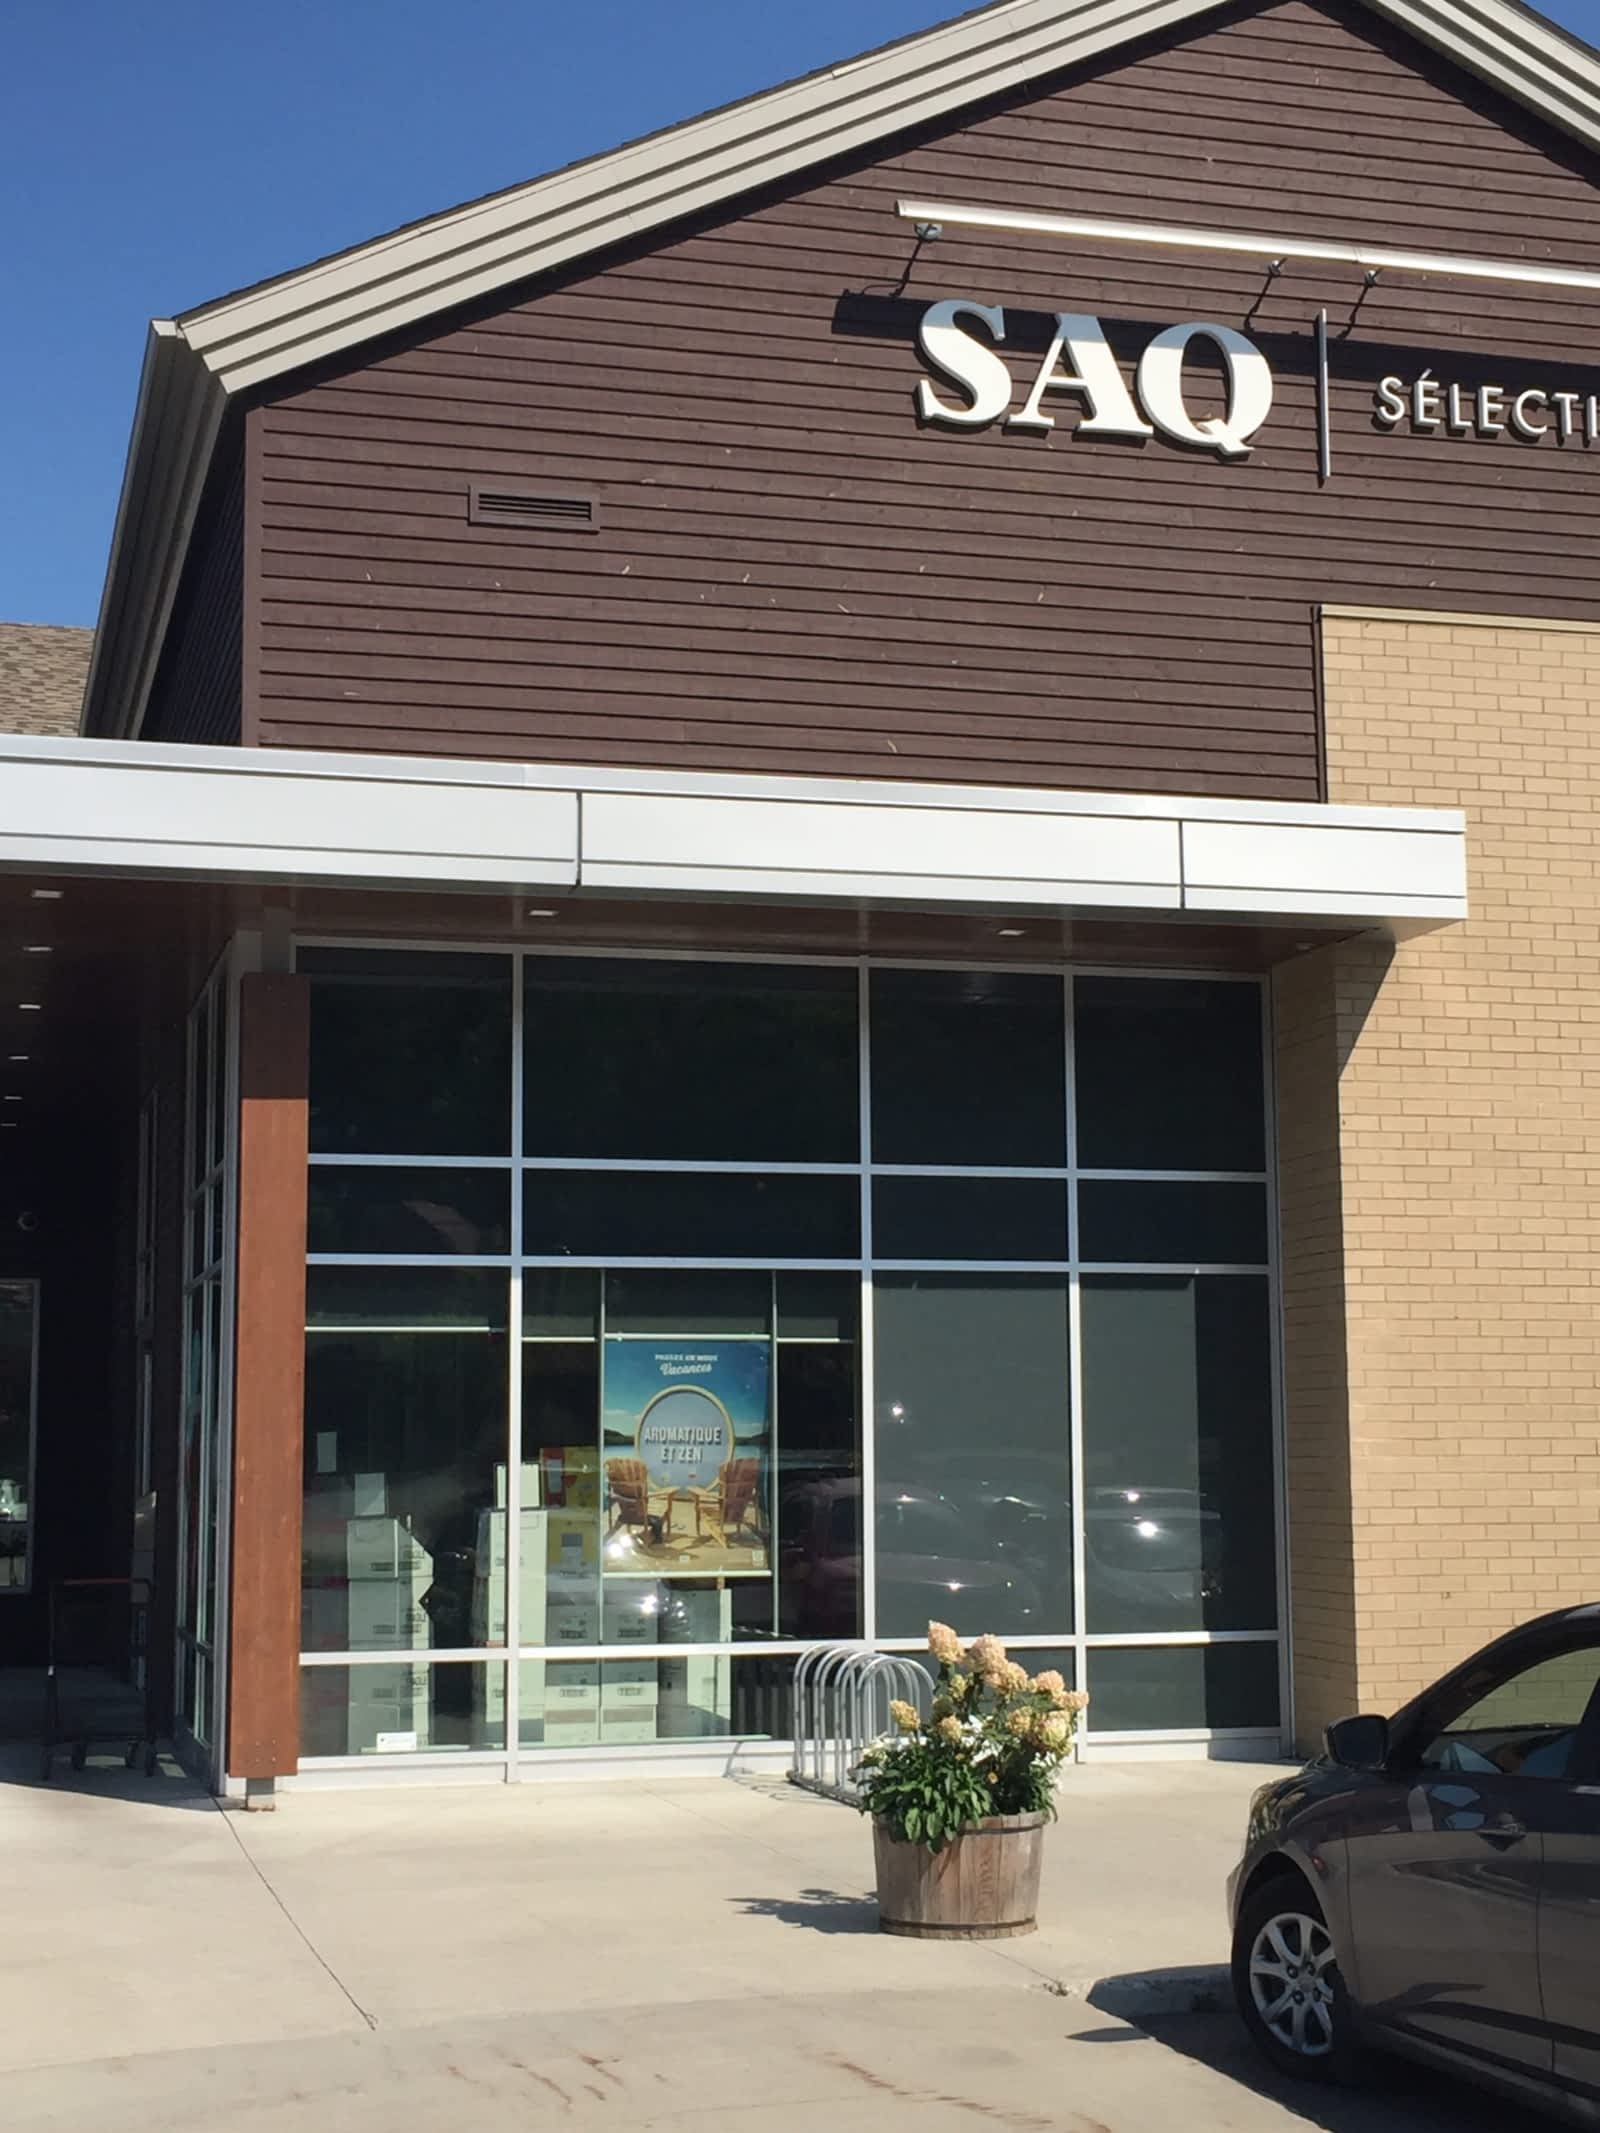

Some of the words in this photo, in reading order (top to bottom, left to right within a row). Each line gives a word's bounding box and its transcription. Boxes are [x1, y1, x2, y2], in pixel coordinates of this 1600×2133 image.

[919, 299, 1274, 456] SAQ
[644, 1426, 722, 1444] AROMATIQUE
[661, 1446, 676, 1463] ET
[678, 1446, 703, 1463] ZEN
